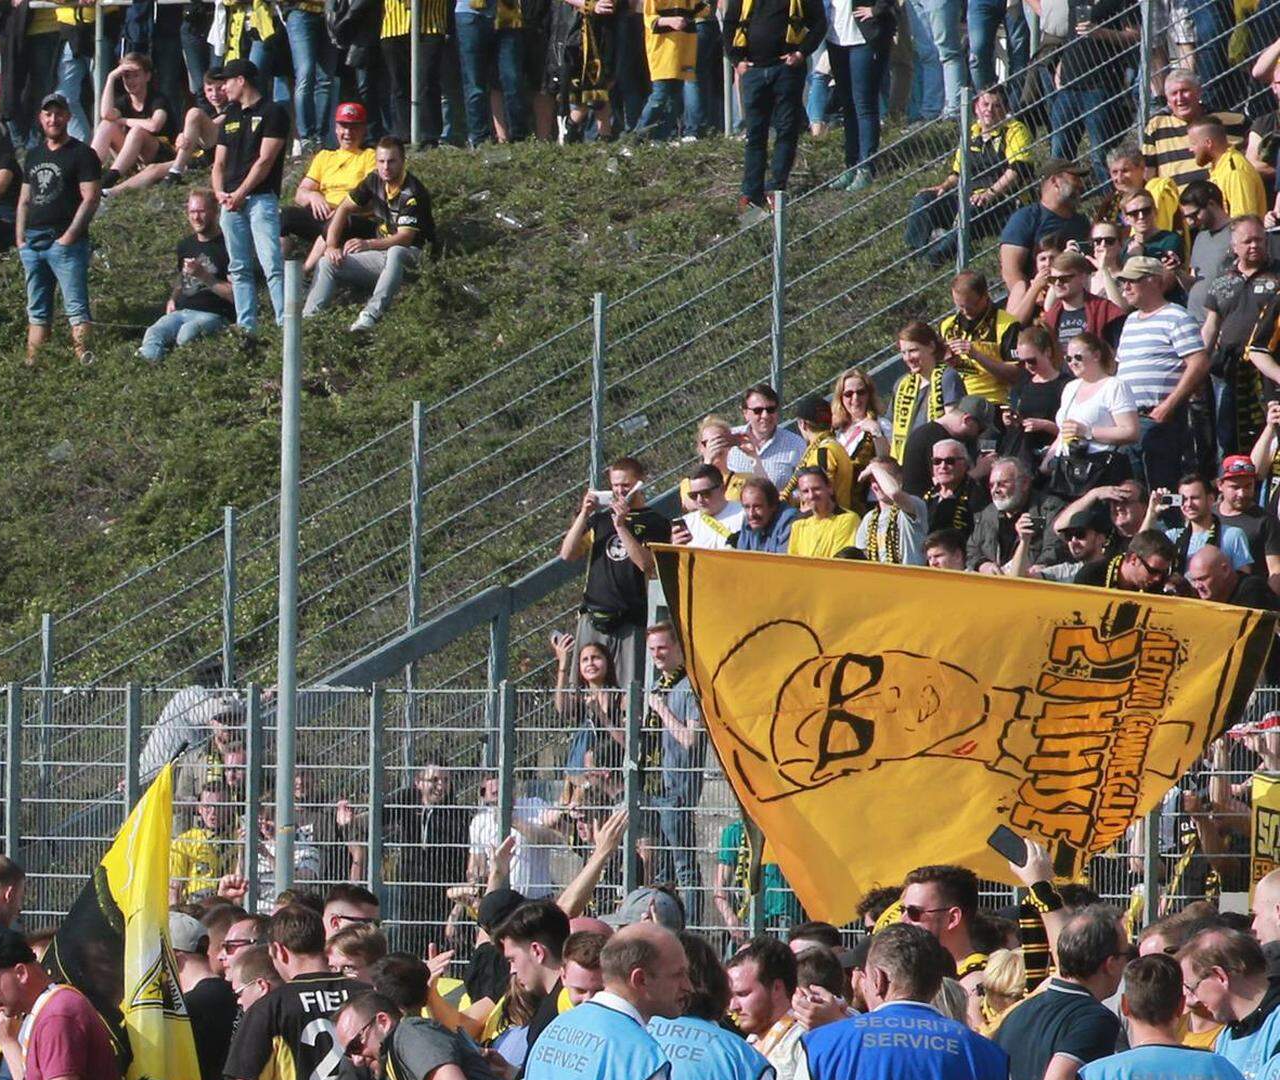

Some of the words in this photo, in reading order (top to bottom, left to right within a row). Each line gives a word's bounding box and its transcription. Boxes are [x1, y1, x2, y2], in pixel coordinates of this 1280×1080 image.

[542, 1023, 607, 1049] SECURITY
[854, 1016, 965, 1035] SECURITY
[863, 1032, 960, 1055] SERVICE
